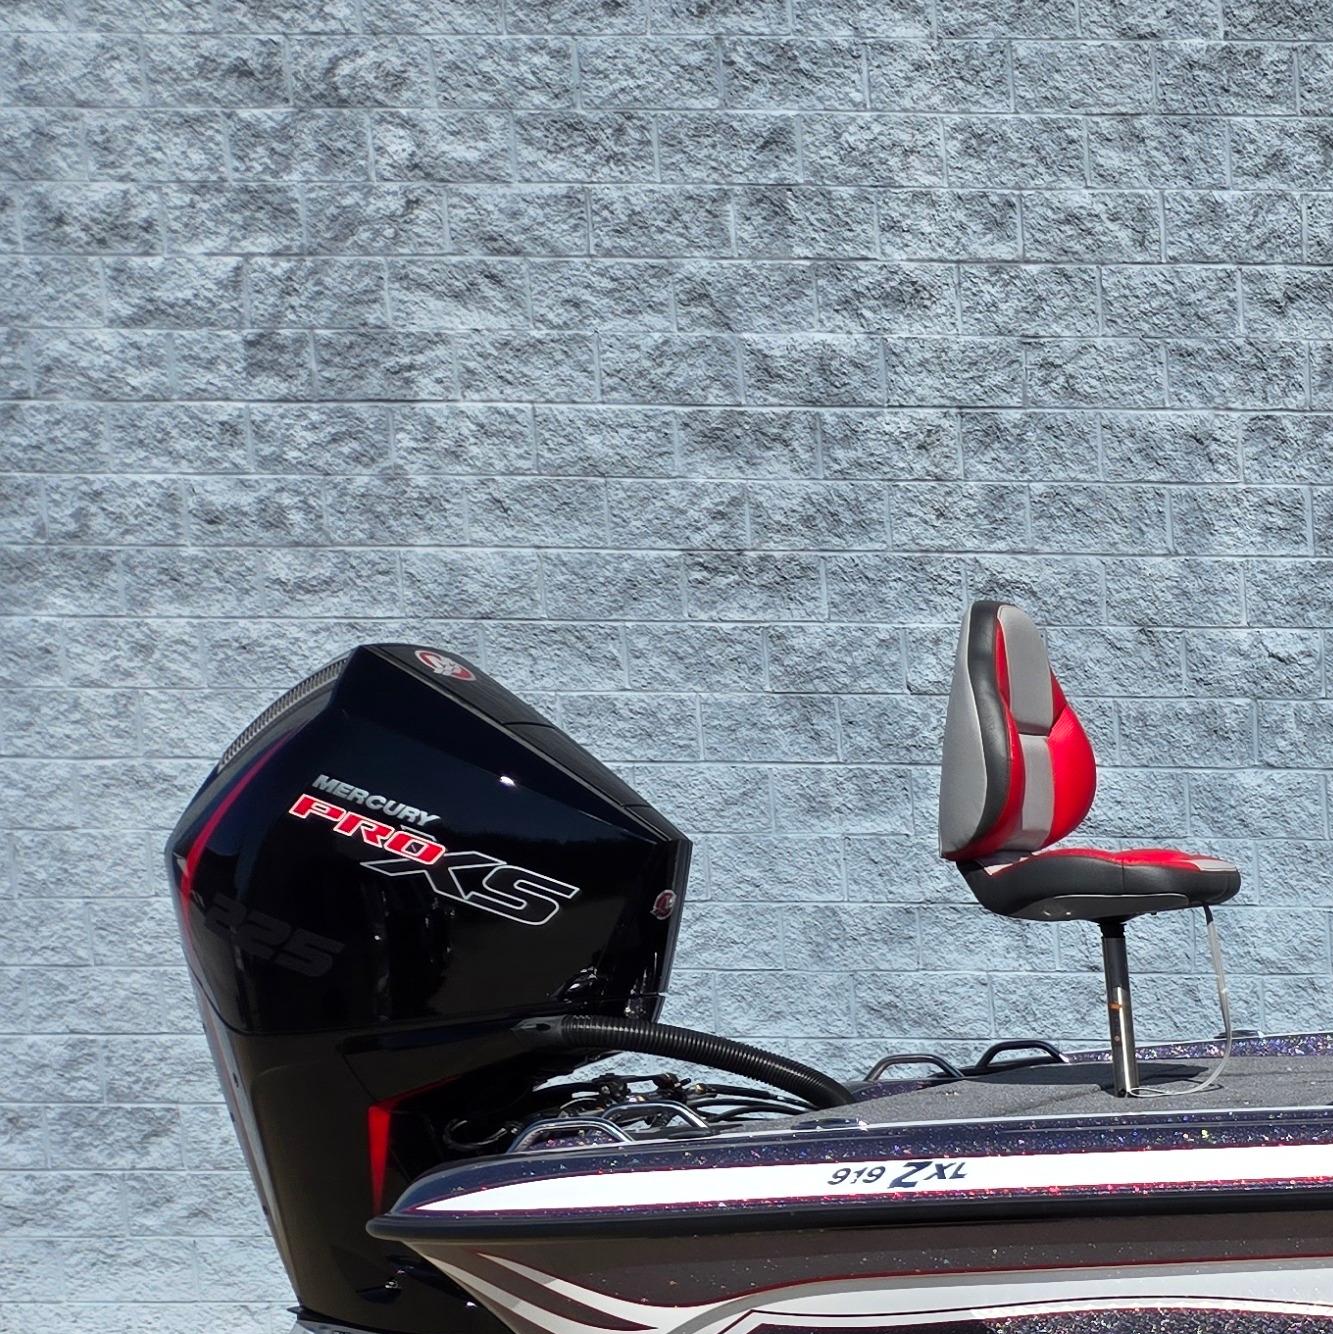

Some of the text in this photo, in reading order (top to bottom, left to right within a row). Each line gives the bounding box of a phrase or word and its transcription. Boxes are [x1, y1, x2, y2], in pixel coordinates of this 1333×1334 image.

[312, 775, 442, 826] MERCURY
[289, 793, 580, 925] PRO XS
[207, 891, 346, 977] 225
[827, 1166, 886, 1186] 919
